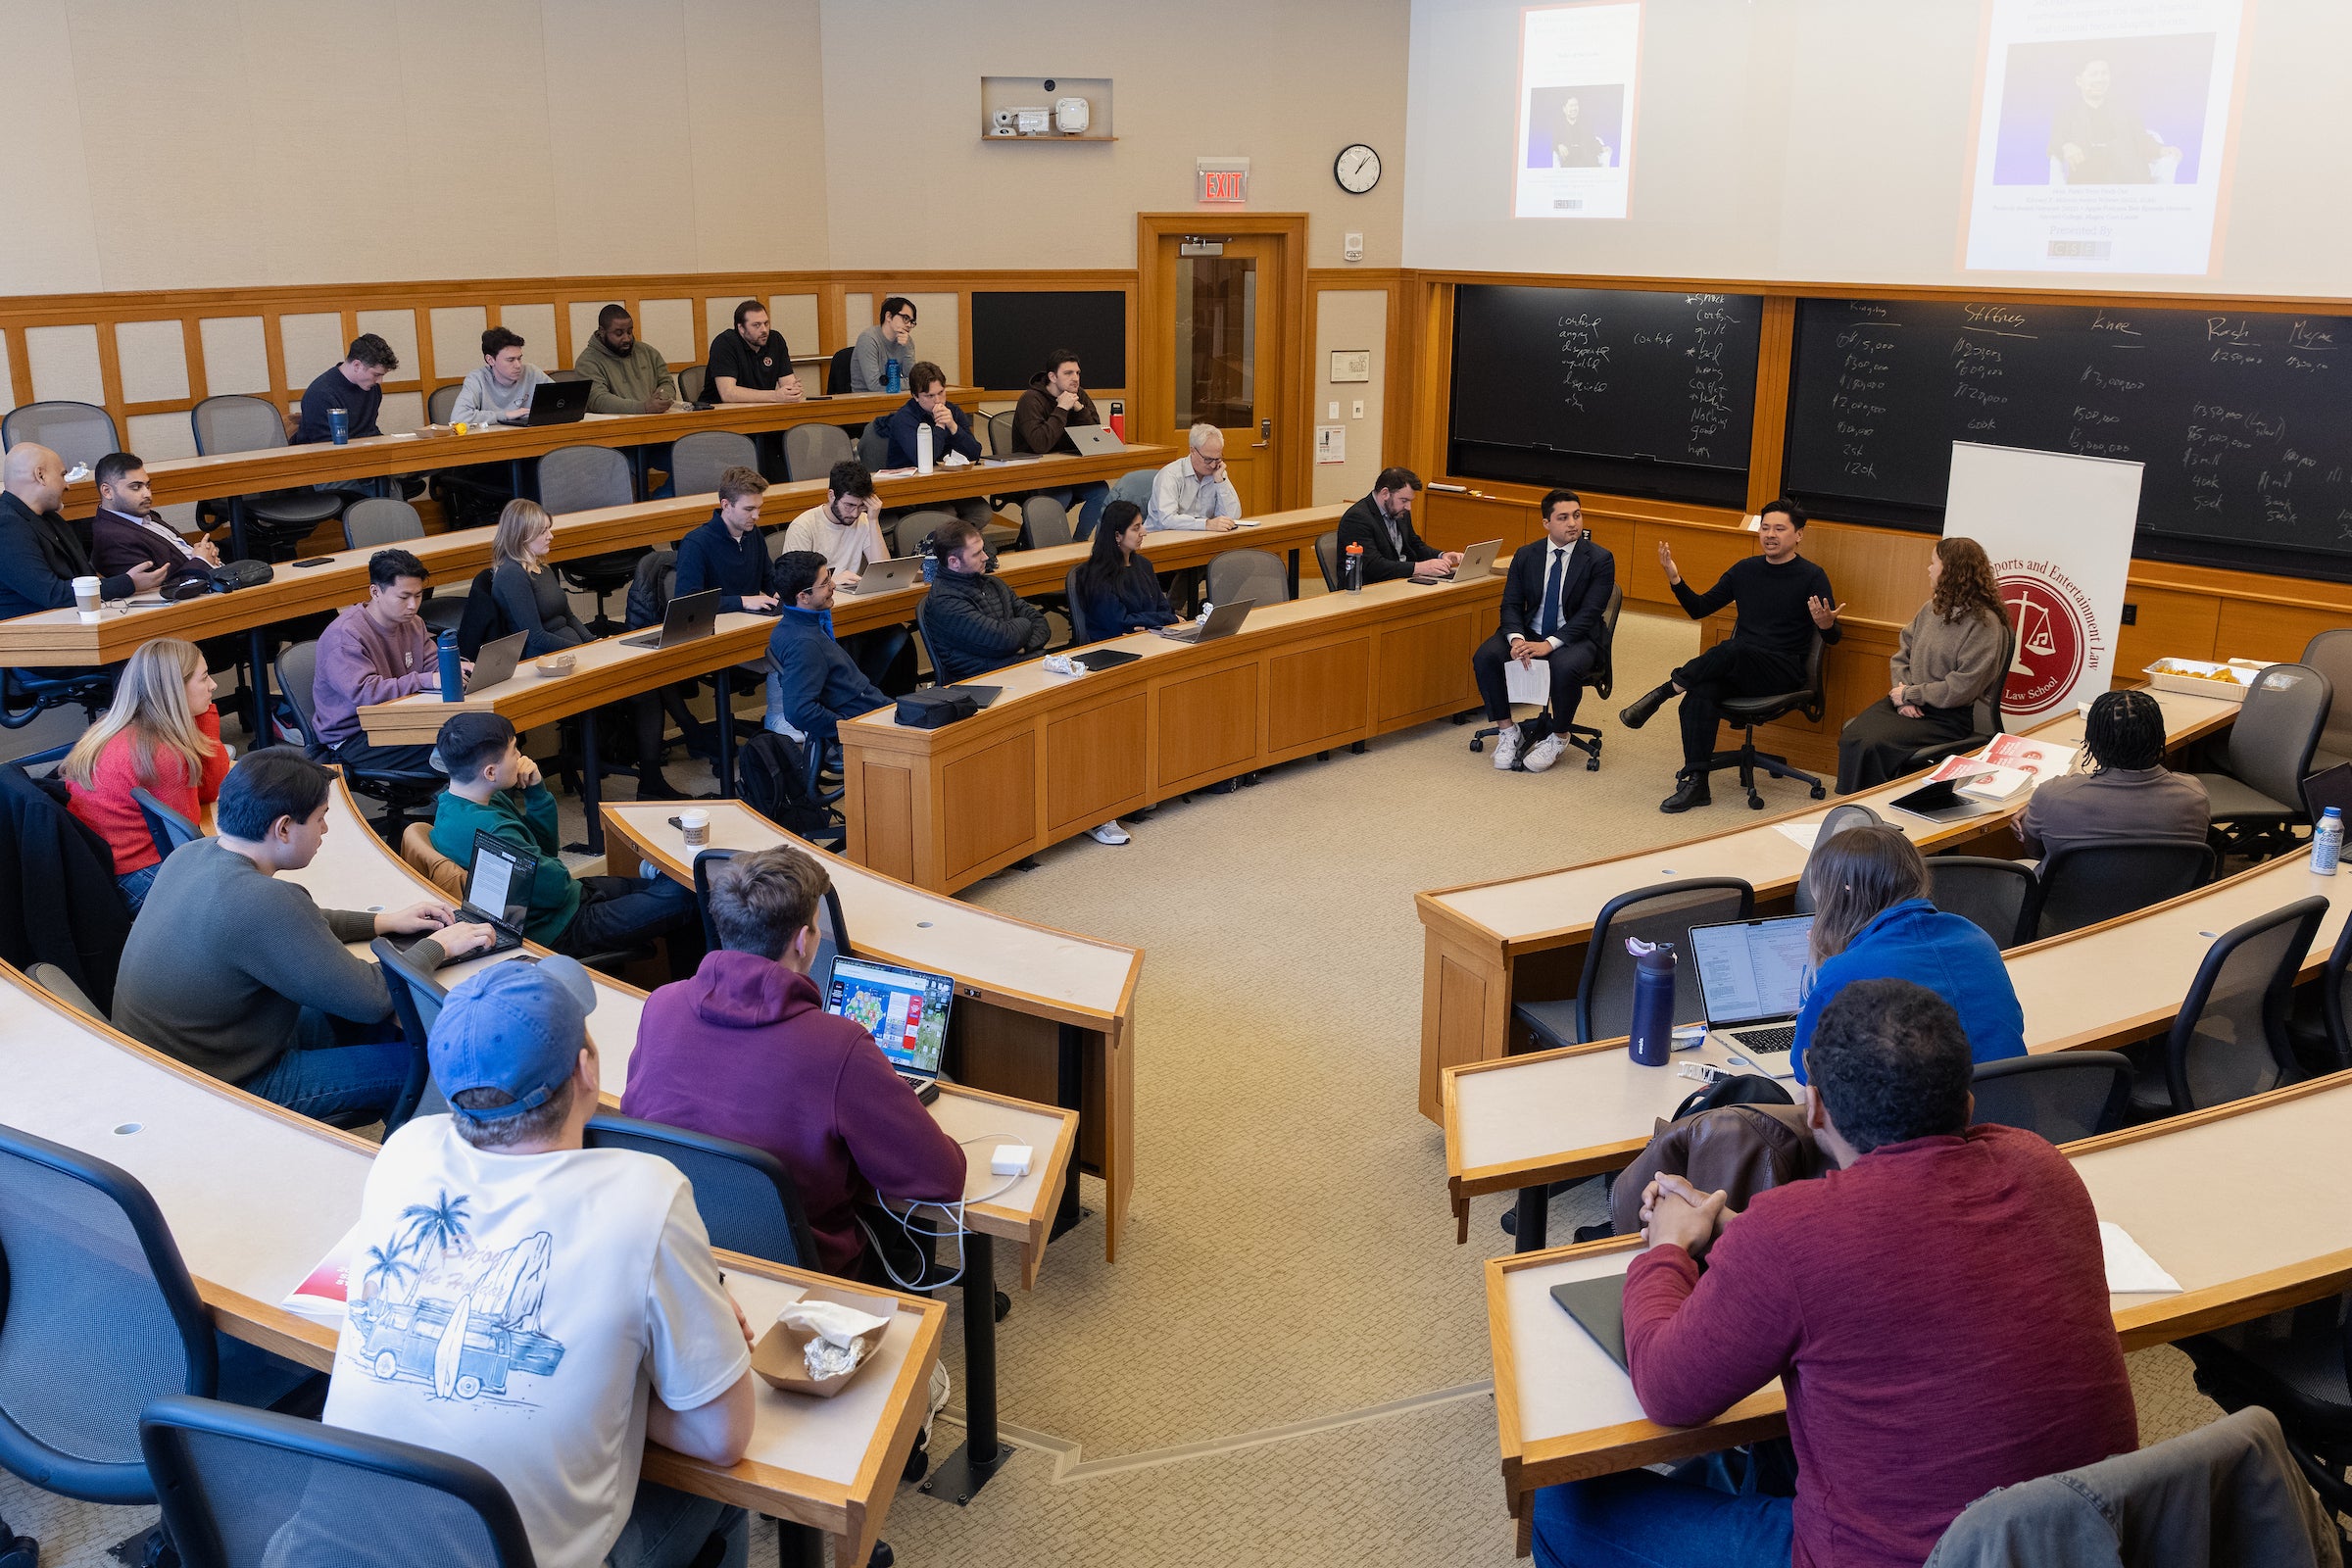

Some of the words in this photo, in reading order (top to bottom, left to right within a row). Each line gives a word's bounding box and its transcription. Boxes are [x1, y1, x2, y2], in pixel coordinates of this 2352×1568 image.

[1205, 172, 1242, 199] EXIT
[2090, 309, 2142, 336] Knee
[2027, 561, 2049, 574] and
[2049, 564, 2102, 643] Entertainment
[2088, 647, 2105, 671] Law
[2005, 689, 2026, 701] Law
[2028, 675, 2058, 700] School
